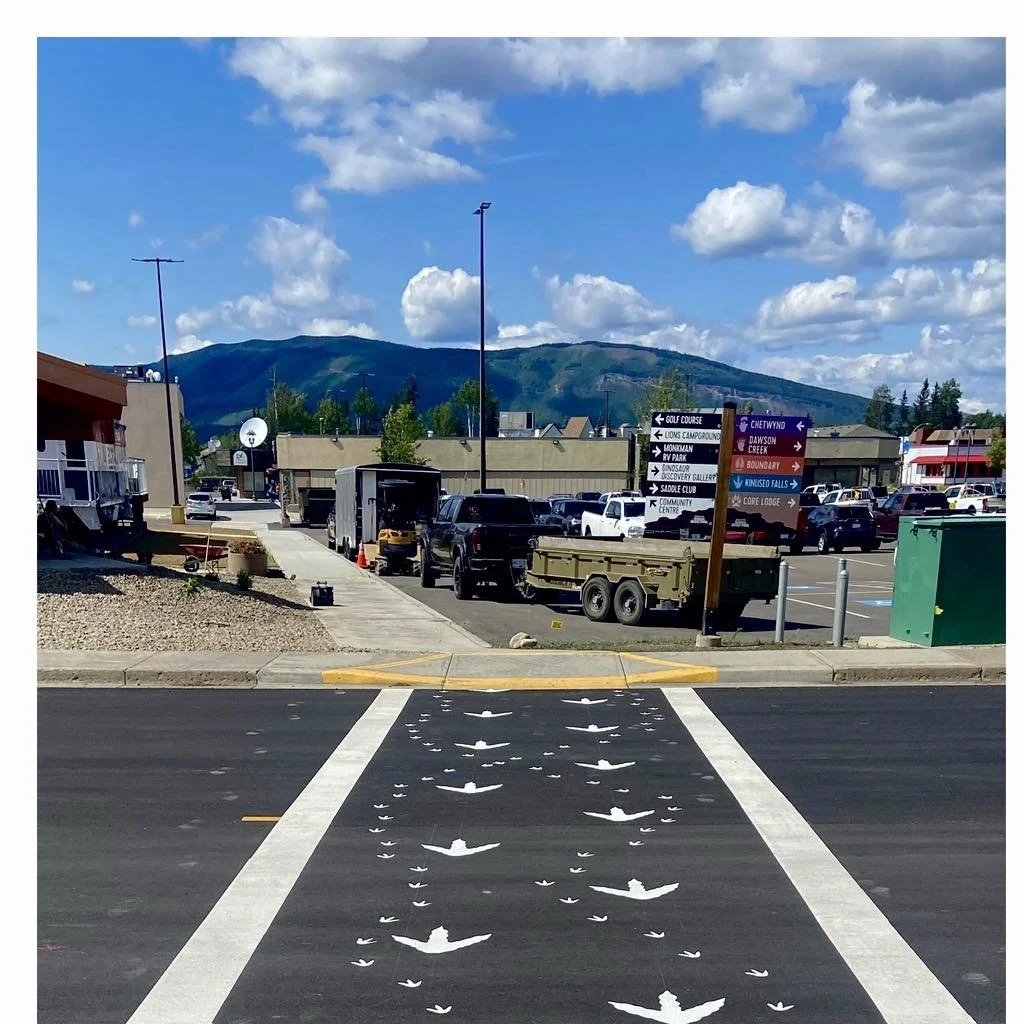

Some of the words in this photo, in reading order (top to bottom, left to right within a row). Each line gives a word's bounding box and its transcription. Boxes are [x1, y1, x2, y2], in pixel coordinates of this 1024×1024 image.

[666, 415, 679, 424] GOLF
[681, 416, 702, 424] COURSE
[751, 422, 785, 430] CHETWYND
[665, 431, 681, 439] LIONS
[682, 431, 720, 440] CAMPGROUND
[749, 436, 776, 444] DAWSON
[664, 444, 693, 453] MONKMAN
[748, 446, 768, 454] CREEK
[663, 453, 671, 461] RV
[672, 454, 686, 462] PARK
[747, 462, 780, 470] BOUNDARY
[745, 478, 770, 487] KINUSEO
[771, 479, 788, 488] FALLS
[661, 485, 680, 493] SADDLE
[682, 486, 696, 494] CLUB
[660, 499, 692, 507] COMMUNITY
[743, 497, 759, 505] CORE
[761, 498, 780, 506] LODGE
